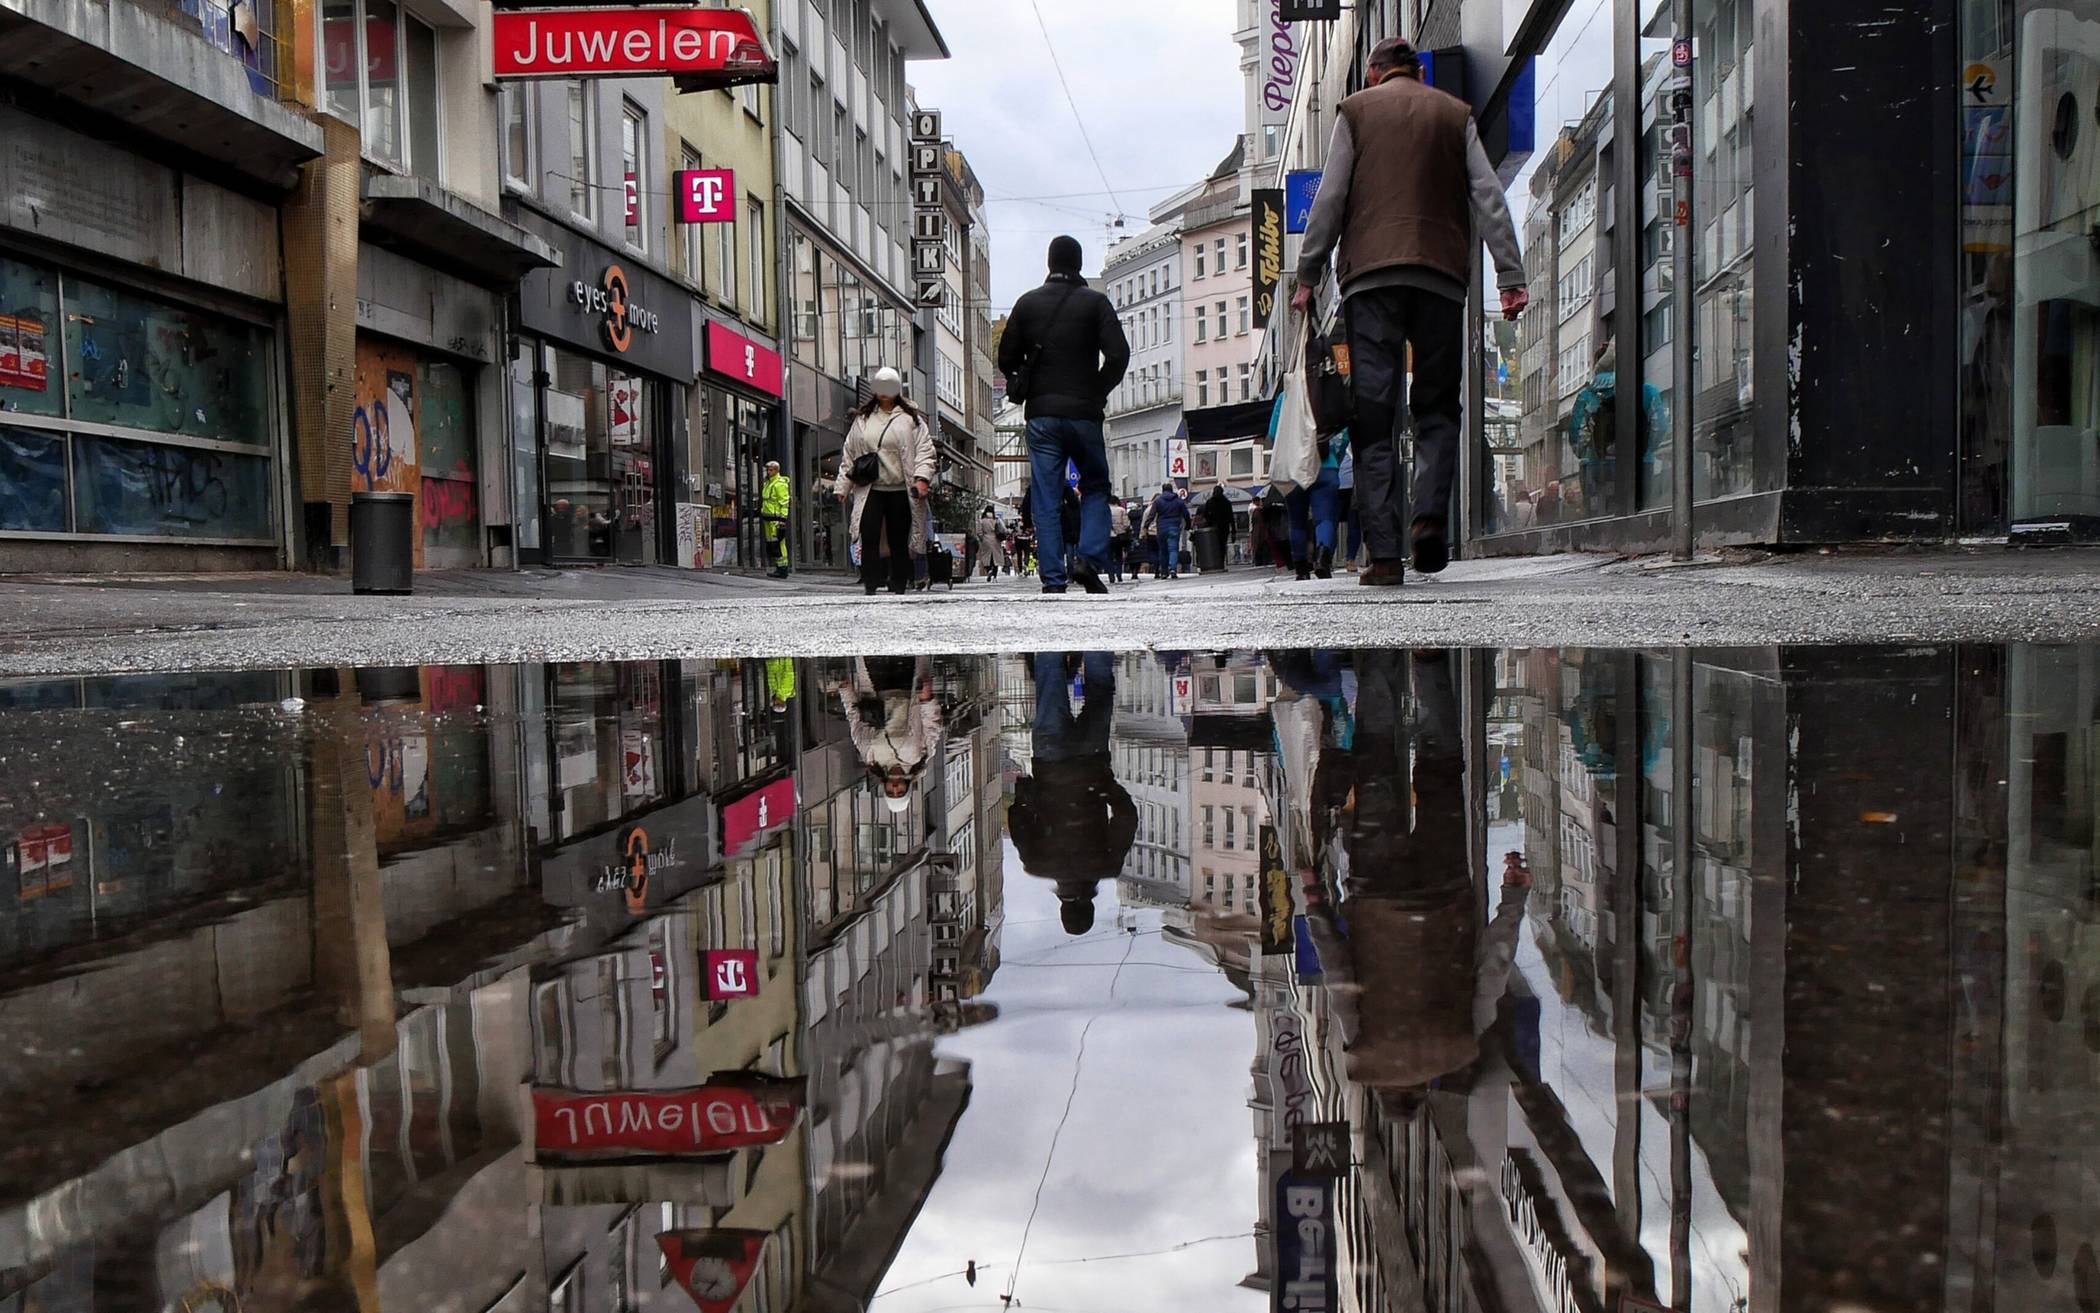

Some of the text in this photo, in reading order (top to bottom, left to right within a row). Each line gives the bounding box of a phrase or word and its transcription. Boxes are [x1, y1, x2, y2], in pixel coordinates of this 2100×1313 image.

[513, 18, 736, 65] Juwelen
[692, 176, 723, 214] T
[919, 115, 940, 269] OPTIK
[1259, 201, 1281, 287] Tchibo
[574, 280, 659, 335] eyes more
